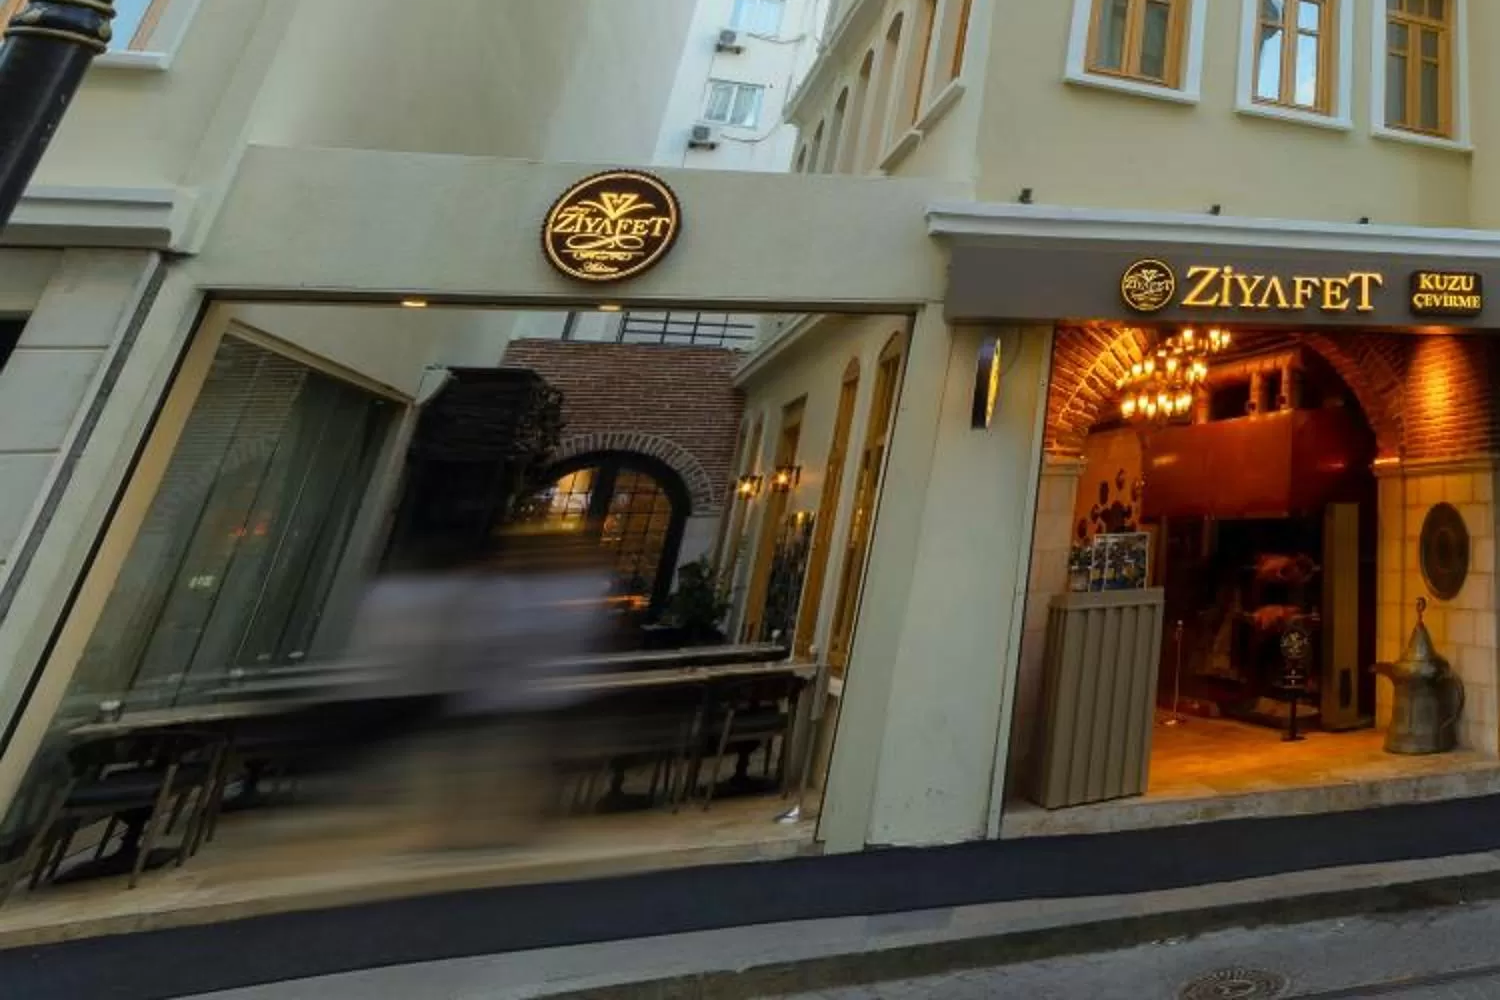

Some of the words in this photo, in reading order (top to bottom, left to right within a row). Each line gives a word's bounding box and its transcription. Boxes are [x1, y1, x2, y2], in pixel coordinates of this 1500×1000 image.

[1181, 265, 1384, 311] ZİYAFET
[1420, 273, 1474, 291] KUZU
[1413, 291, 1481, 309] ÇEVİRME
